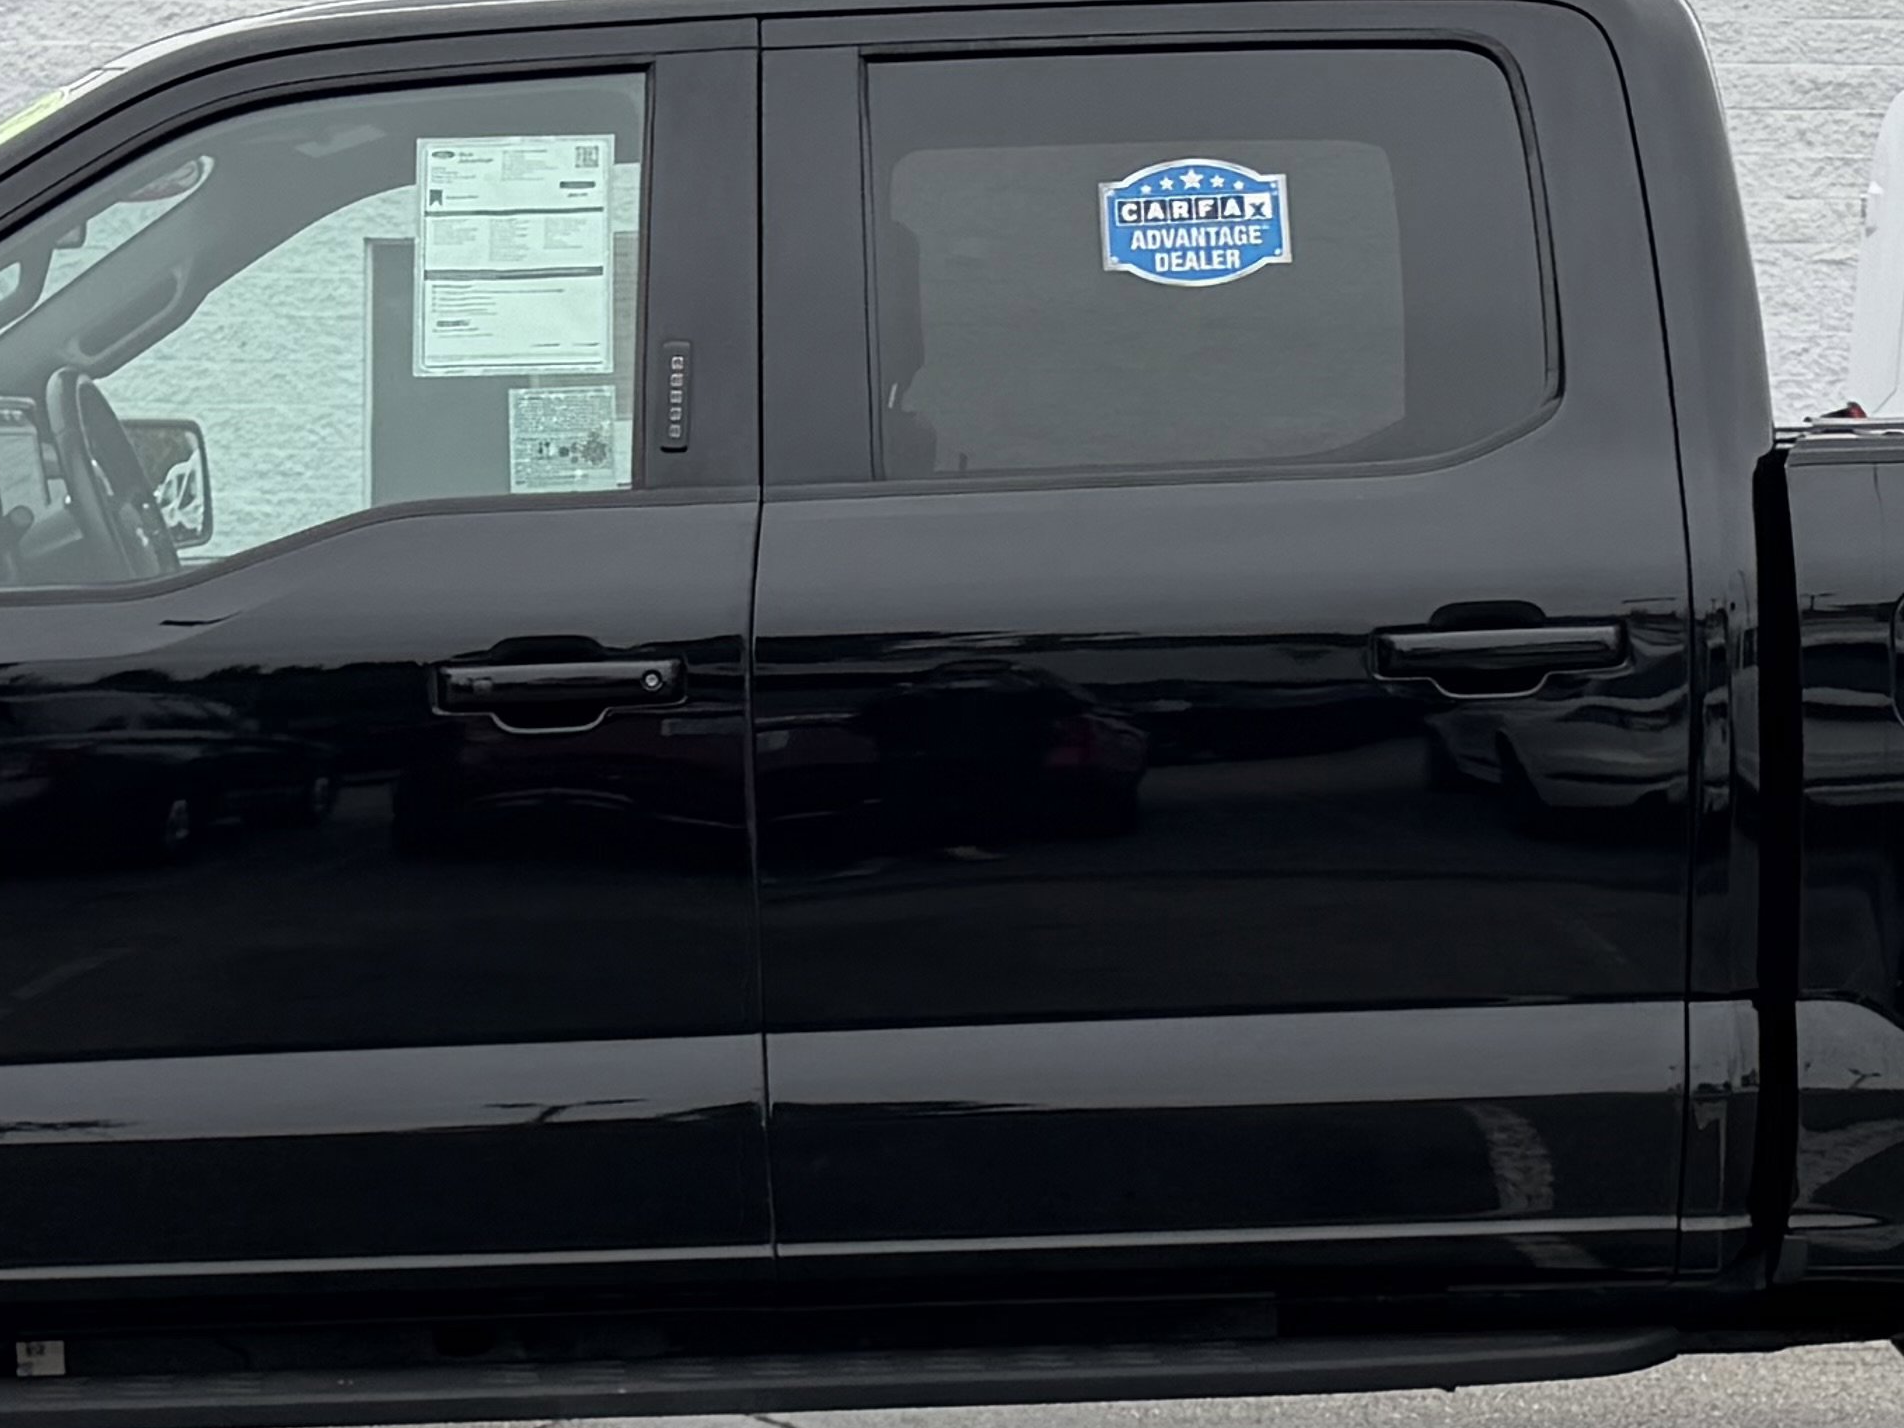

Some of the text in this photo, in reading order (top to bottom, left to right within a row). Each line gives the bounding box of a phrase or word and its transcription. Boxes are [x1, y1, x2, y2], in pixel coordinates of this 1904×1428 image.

[1117, 194, 1270, 224] CARFAX
[1130, 224, 1264, 251] ADVANTAGE
[1153, 248, 1241, 272] DEALER
